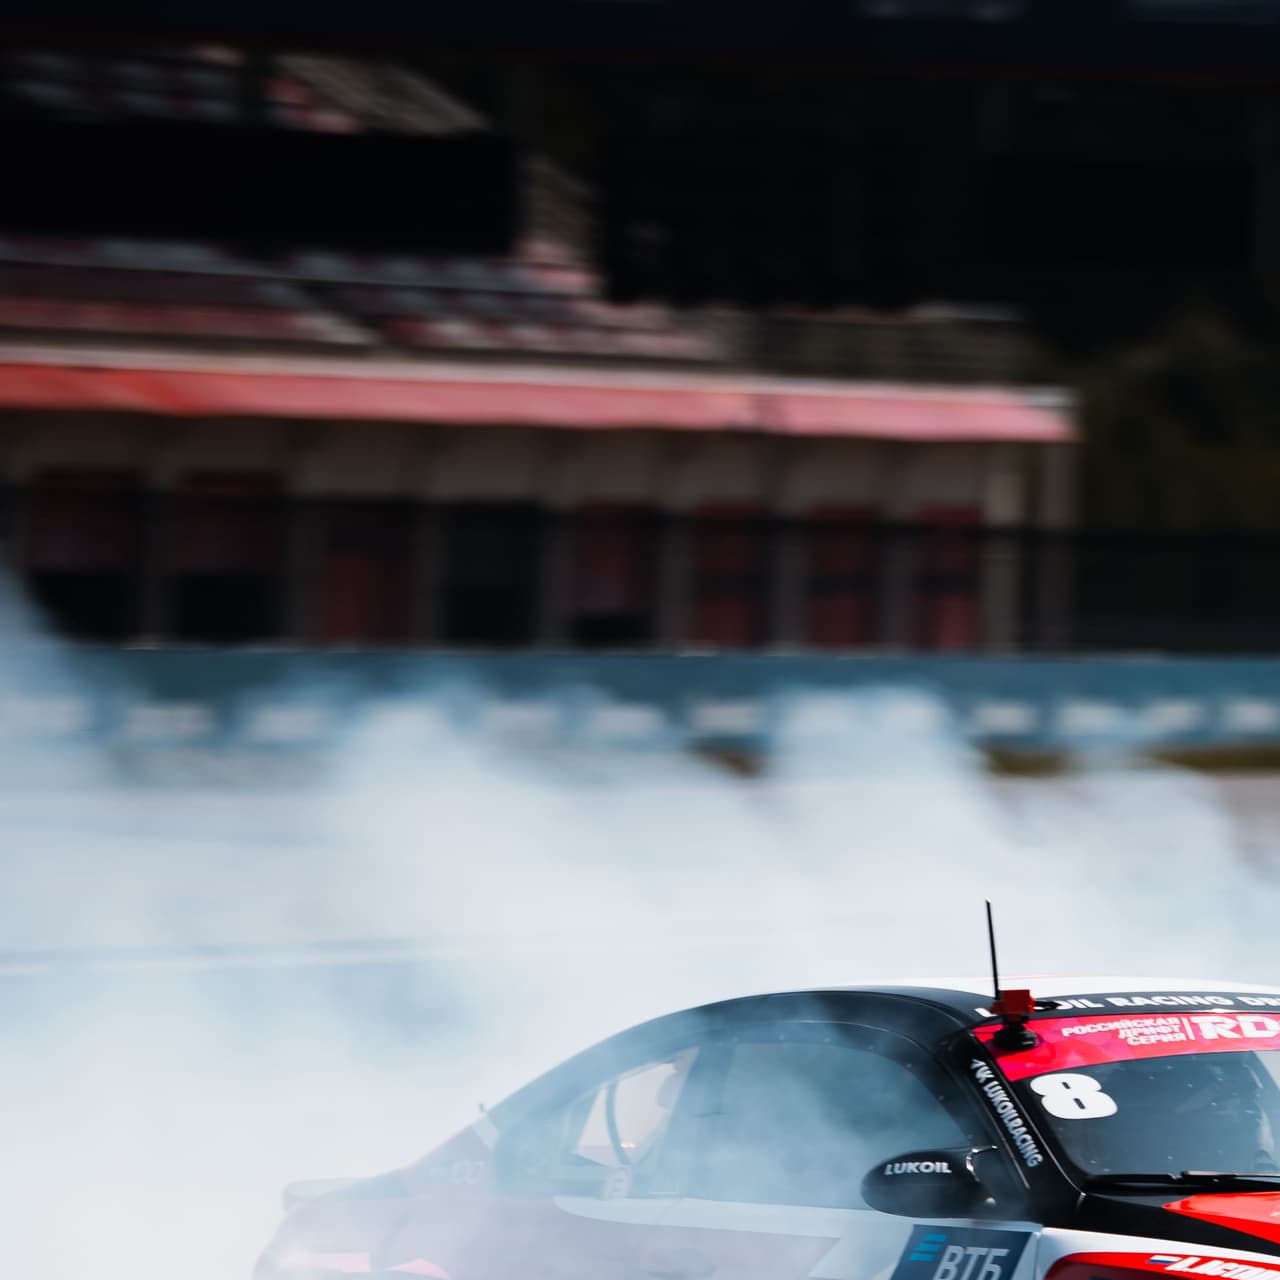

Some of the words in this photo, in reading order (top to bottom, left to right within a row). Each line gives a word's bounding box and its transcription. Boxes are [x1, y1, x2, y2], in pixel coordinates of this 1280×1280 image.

[1105, 995, 1229, 1010] RACING
[1061, 1016, 1182, 1037] РОССИЙСКАЯ
[1118, 1024, 1181, 1040] ДРИФТ
[1127, 1032, 1187, 1046] СЕРИЯ
[1030, 1073, 1118, 1120] 8
[884, 1162, 952, 1175] LUKOIL
